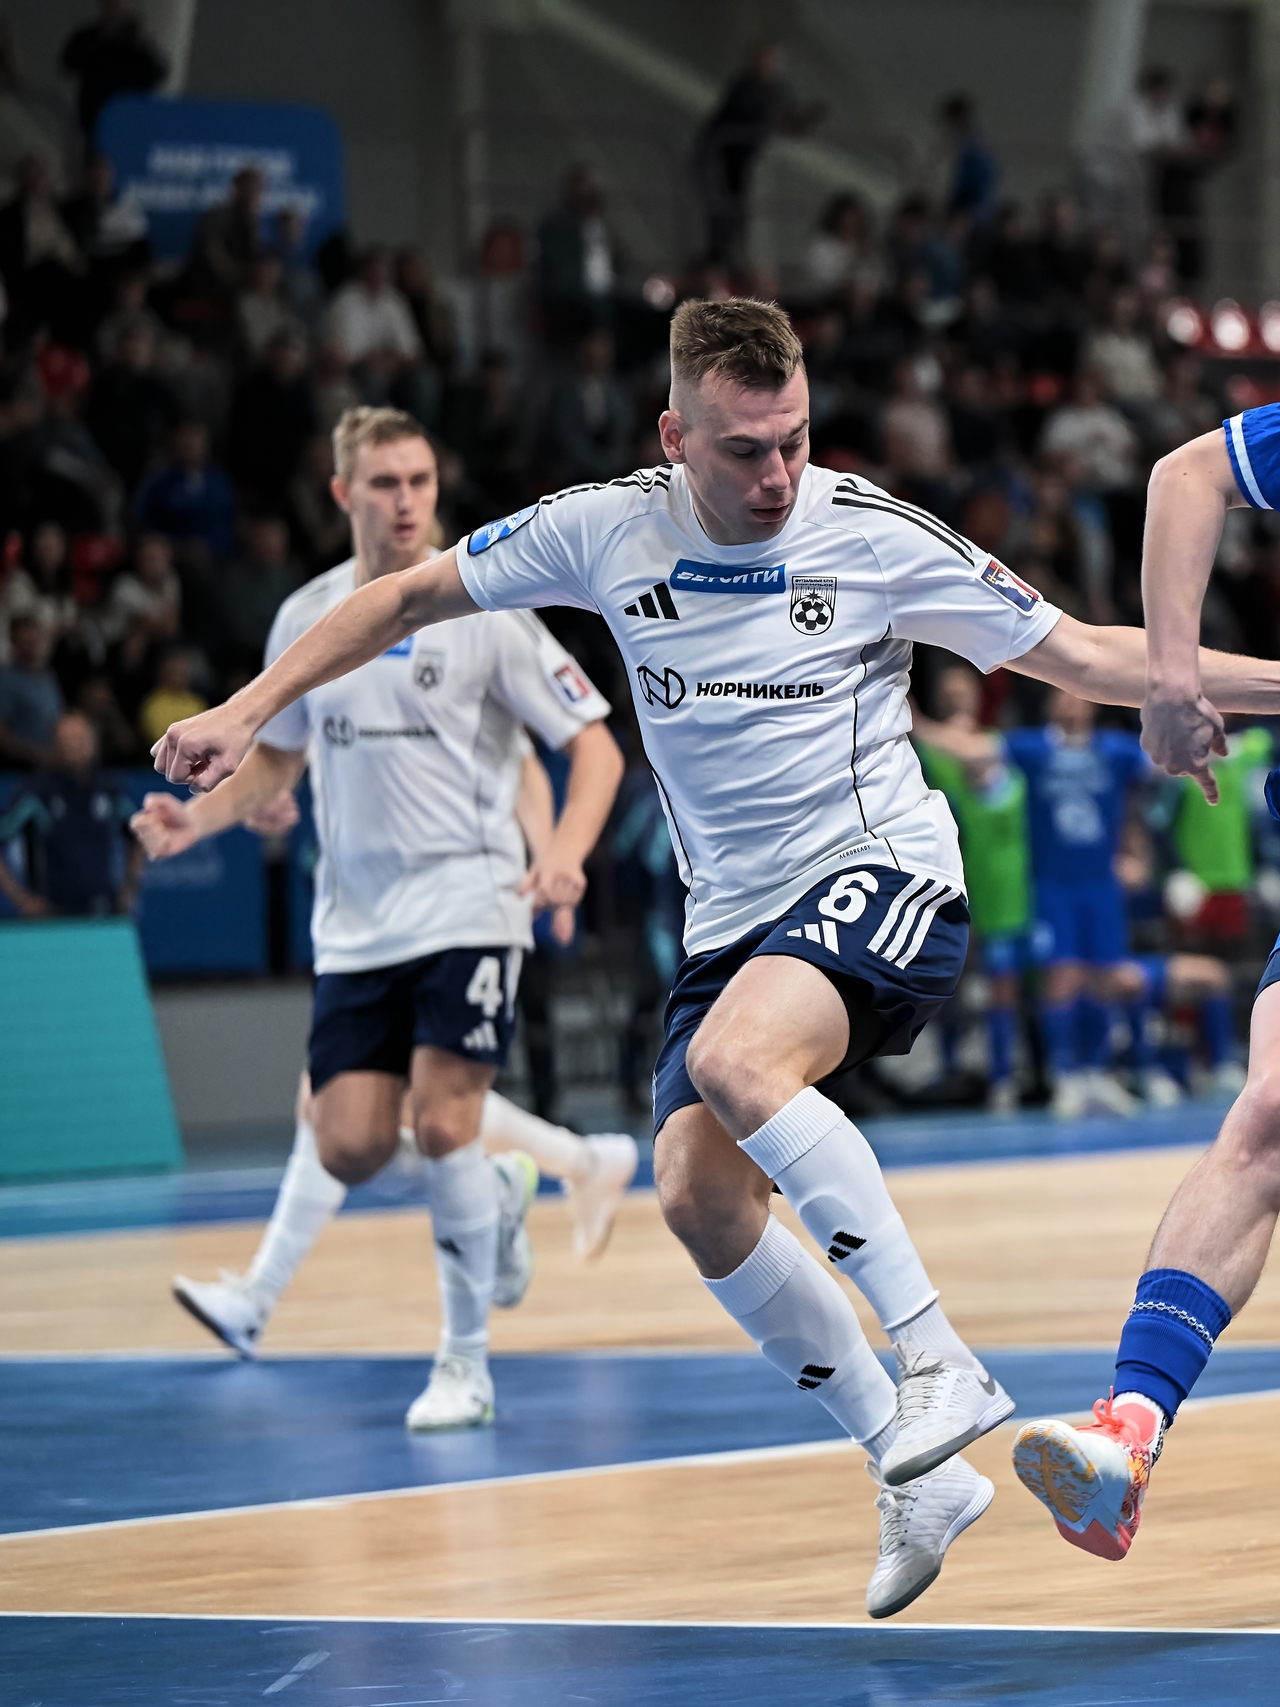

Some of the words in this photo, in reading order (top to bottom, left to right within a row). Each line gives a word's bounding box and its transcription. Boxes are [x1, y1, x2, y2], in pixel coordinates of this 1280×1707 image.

[696, 682, 824, 699] НОРНИКЕЛЬ
[839, 844, 871, 859] AEROREADY
[818, 870, 879, 923] 6
[466, 955, 502, 1017] 4
